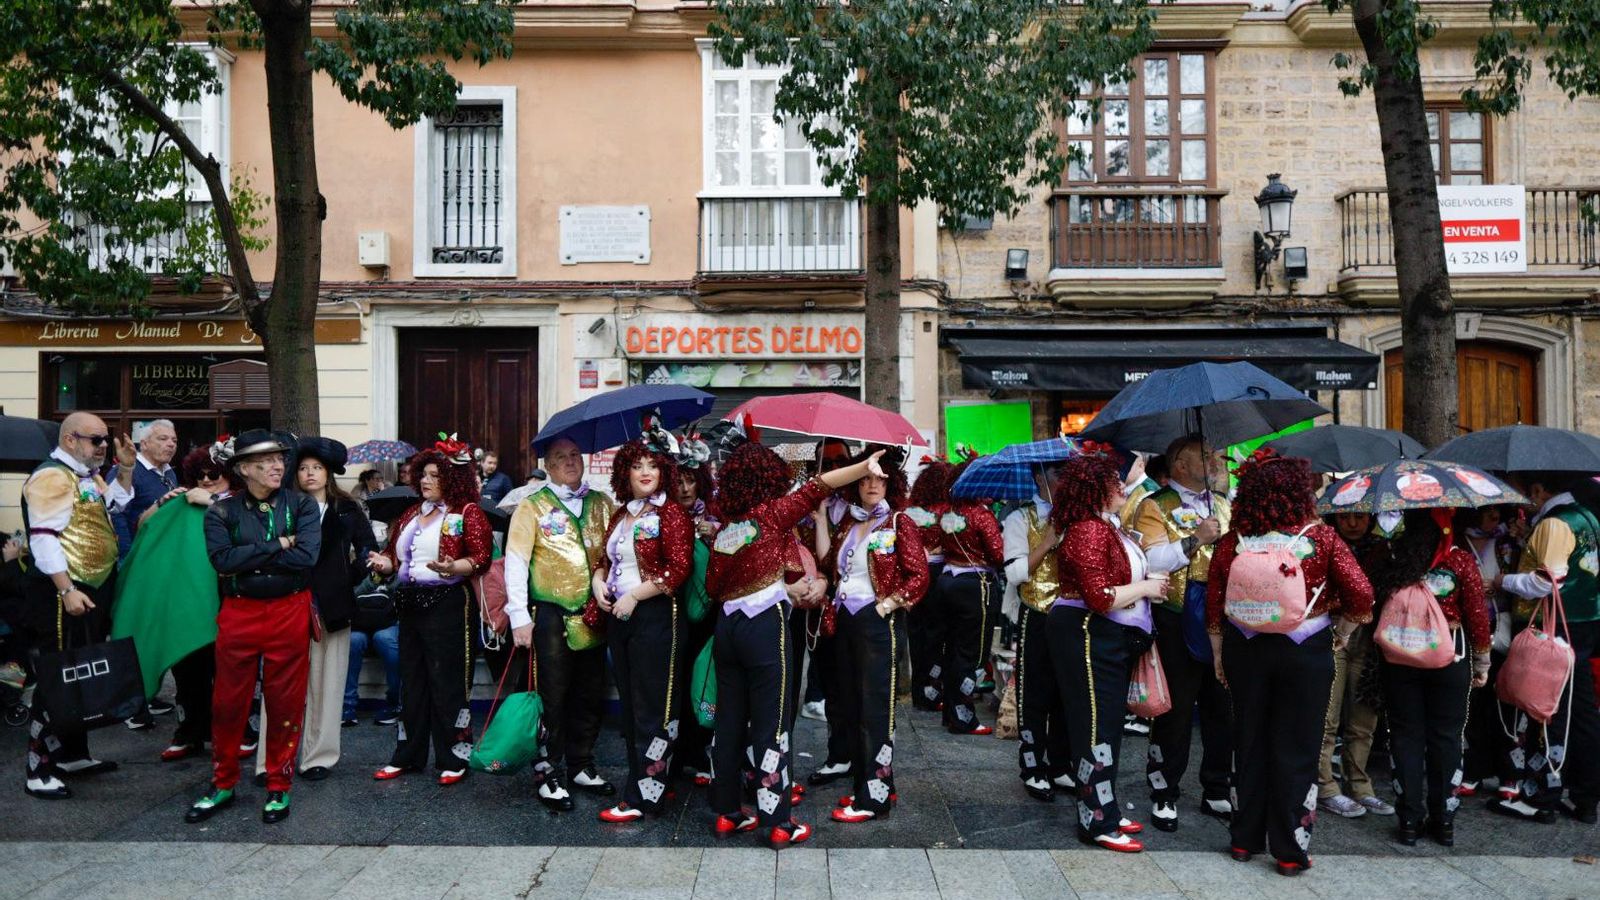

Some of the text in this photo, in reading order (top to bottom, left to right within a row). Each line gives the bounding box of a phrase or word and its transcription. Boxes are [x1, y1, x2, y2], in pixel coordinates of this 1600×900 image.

[1444, 225, 1500, 237] EN VENTA
[1462, 251, 1490, 265] 328
[1495, 250, 1519, 264] 149
[38, 321, 100, 341] Libreria
[116, 321, 181, 340] Manuel
[198, 321, 224, 338] De
[626, 326, 863, 354] DEPORTES DELMO
[133, 364, 209, 379] LIBRERI
[991, 370, 1029, 381] Mahou
[1315, 370, 1352, 381] Mahou
